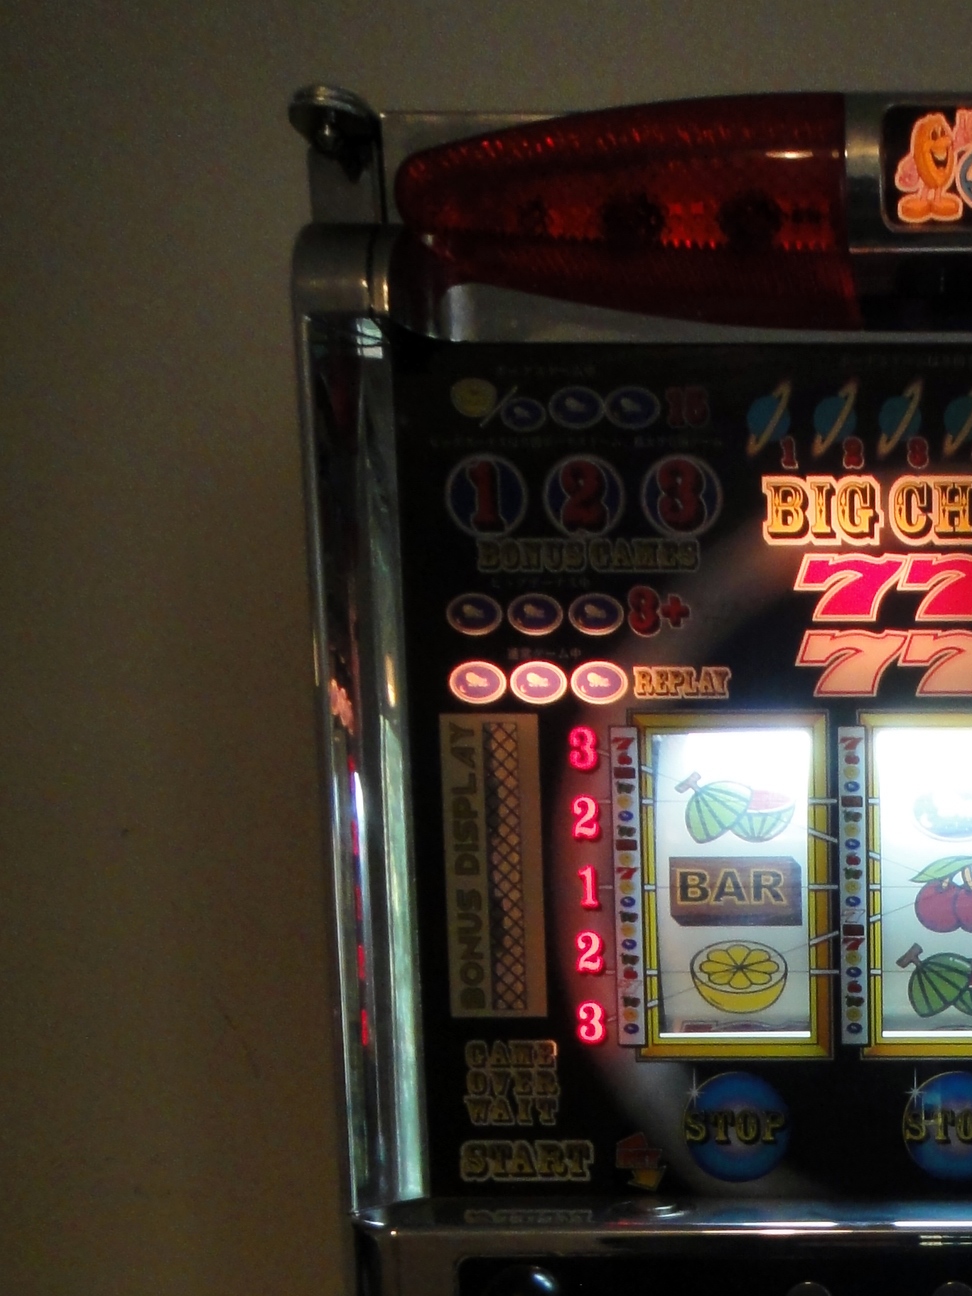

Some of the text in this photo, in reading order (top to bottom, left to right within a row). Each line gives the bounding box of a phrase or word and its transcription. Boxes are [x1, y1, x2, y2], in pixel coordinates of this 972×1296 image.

[460, 459, 509, 534] 1
[561, 459, 608, 535] 2
[658, 459, 707, 533] 3
[762, 474, 881, 545] BIG
[477, 538, 700, 573] BONUS GAMES
[632, 667, 731, 699] REPLAY
[568, 726, 598, 771] 3
[572, 796, 599, 841] 2
[449, 721, 485, 1012] BONUS DISPLAY
[578, 866, 600, 909] 1
[676, 871, 786, 905] BAR
[574, 930, 604, 974] 2
[578, 1000, 606, 1044] 3
[464, 1040, 558, 1069] GAME
[464, 1067, 558, 1098] OVER
[464, 1096, 559, 1125] WAIT
[684, 1109, 786, 1142] STOP
[461, 1140, 594, 1181] START
